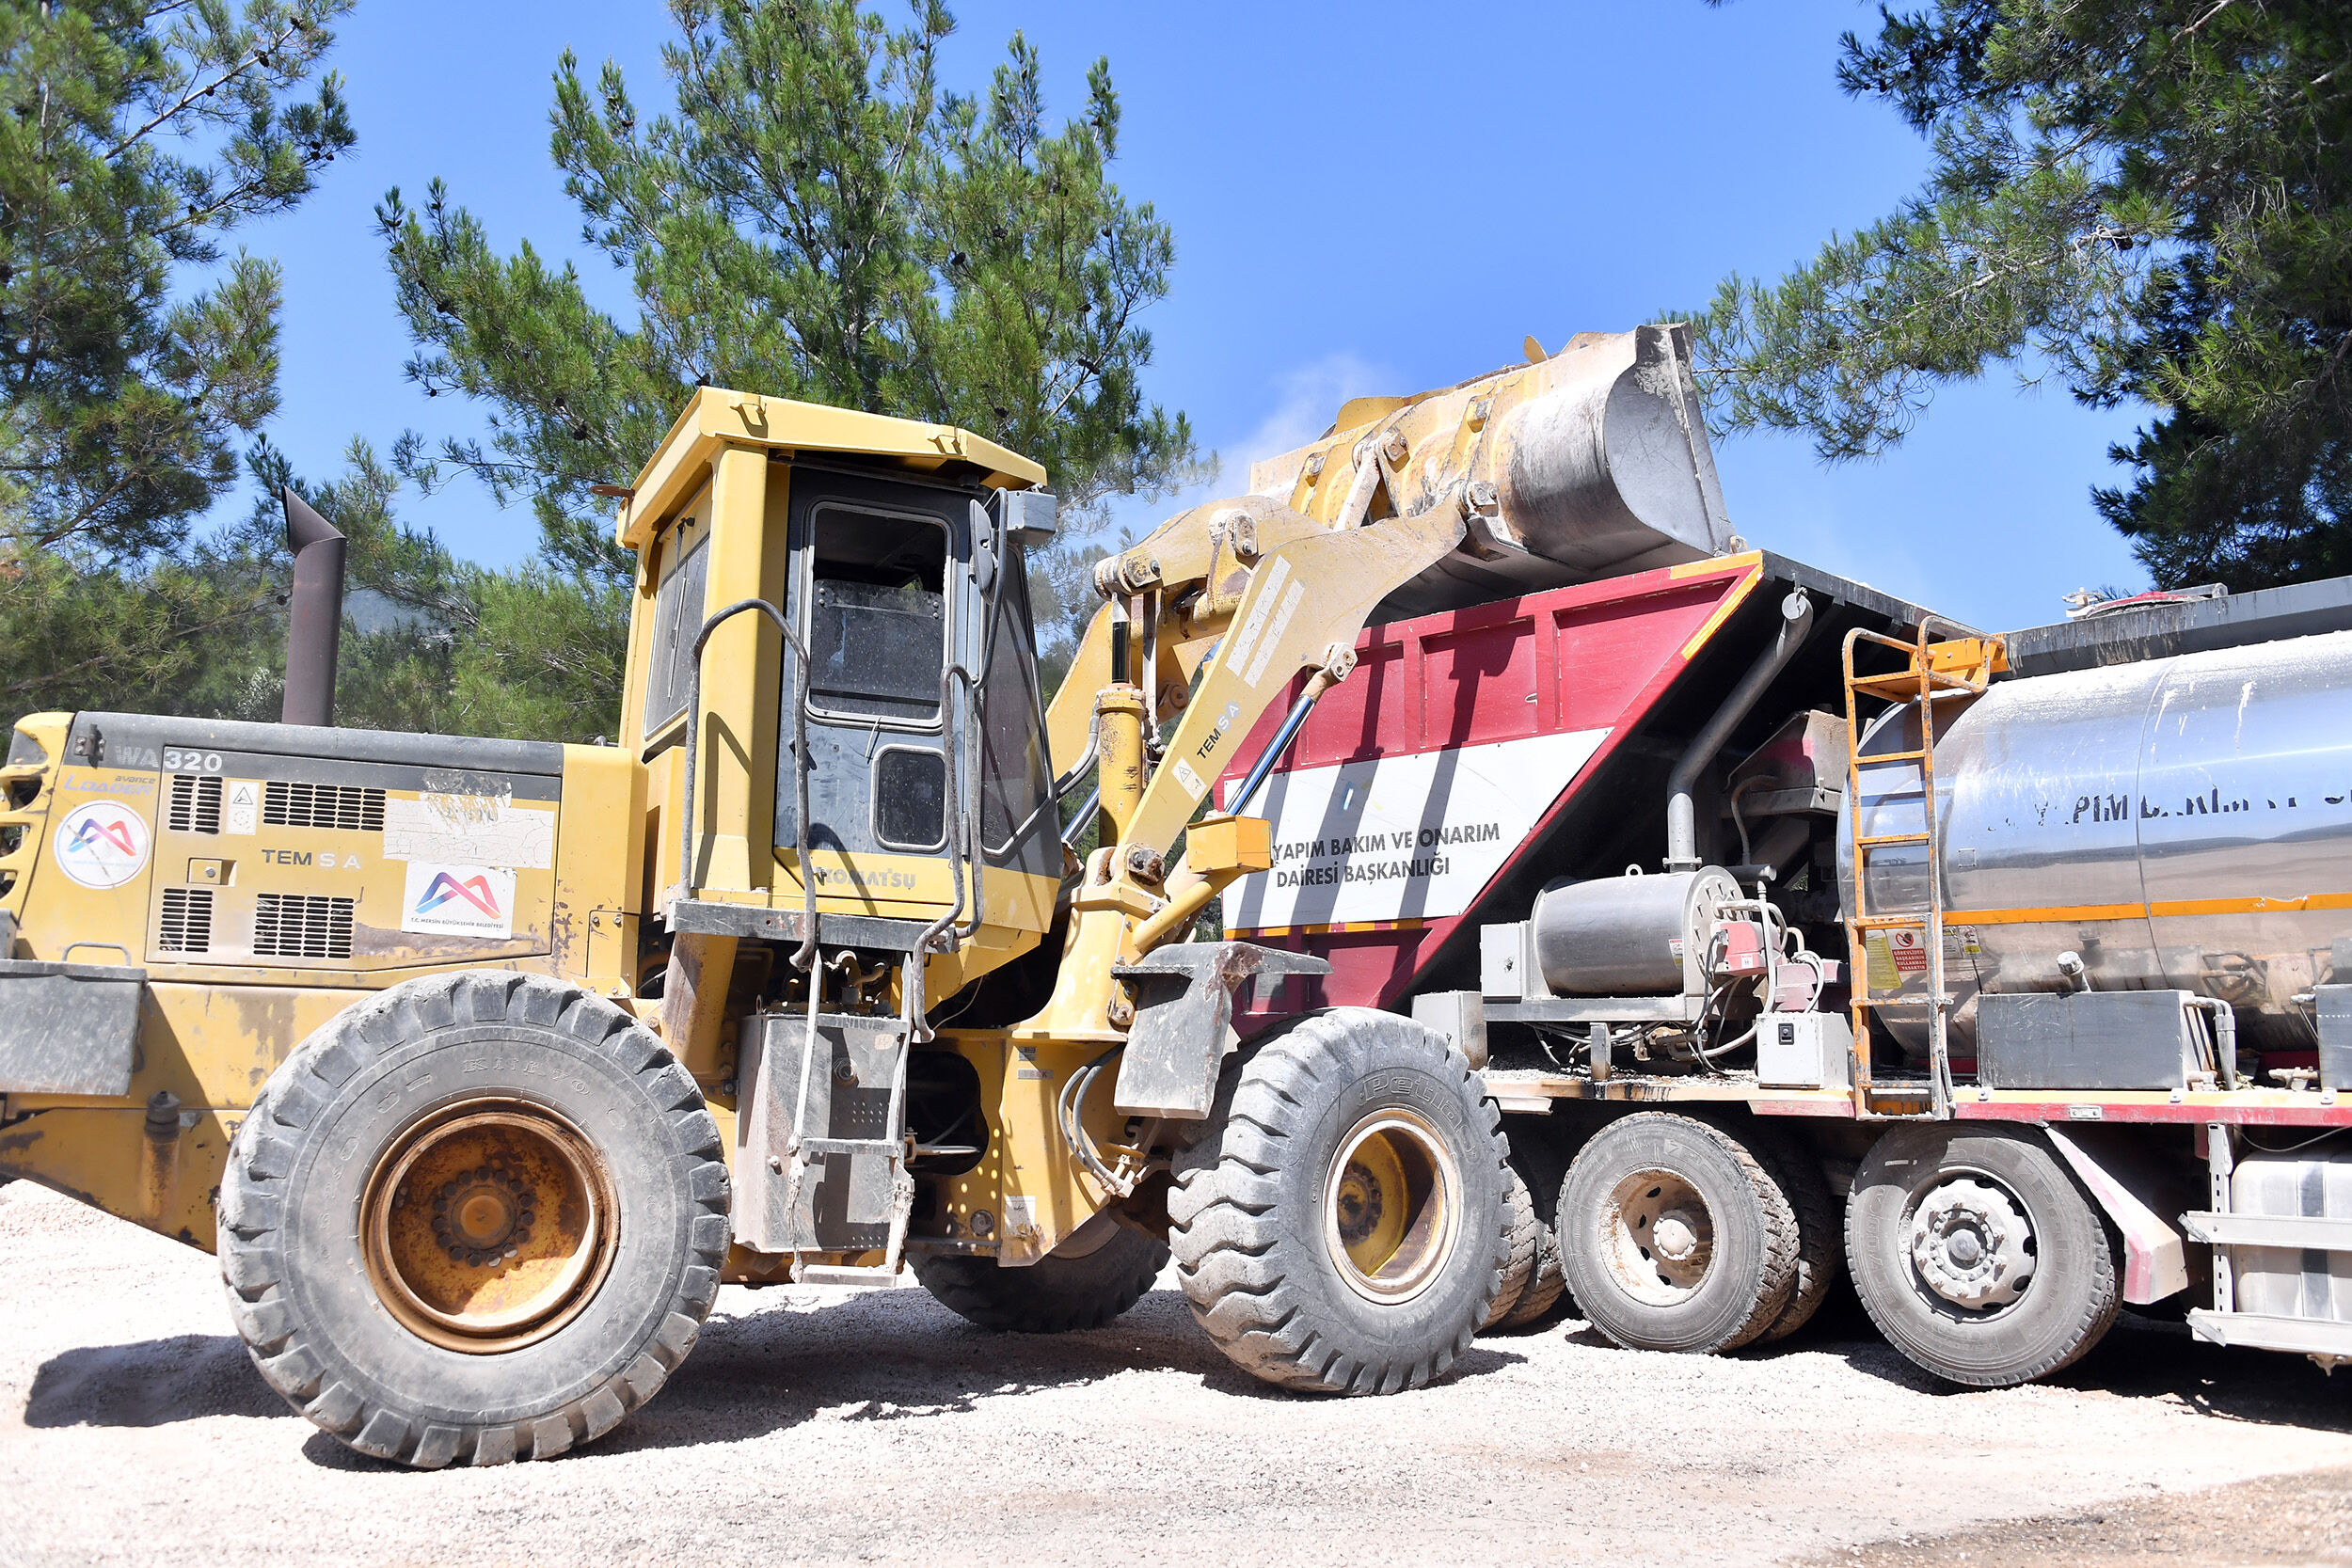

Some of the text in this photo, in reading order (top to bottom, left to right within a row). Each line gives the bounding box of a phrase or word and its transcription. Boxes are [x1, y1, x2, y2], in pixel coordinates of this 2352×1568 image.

[1196, 705, 1240, 759] TEMSA
[115, 775, 156, 784] avance
[1273, 822, 1501, 861] YAPIM BAKIM VE ONARIM
[1277, 851, 1450, 888] DAİRESİ BAŞKANLIĞI
